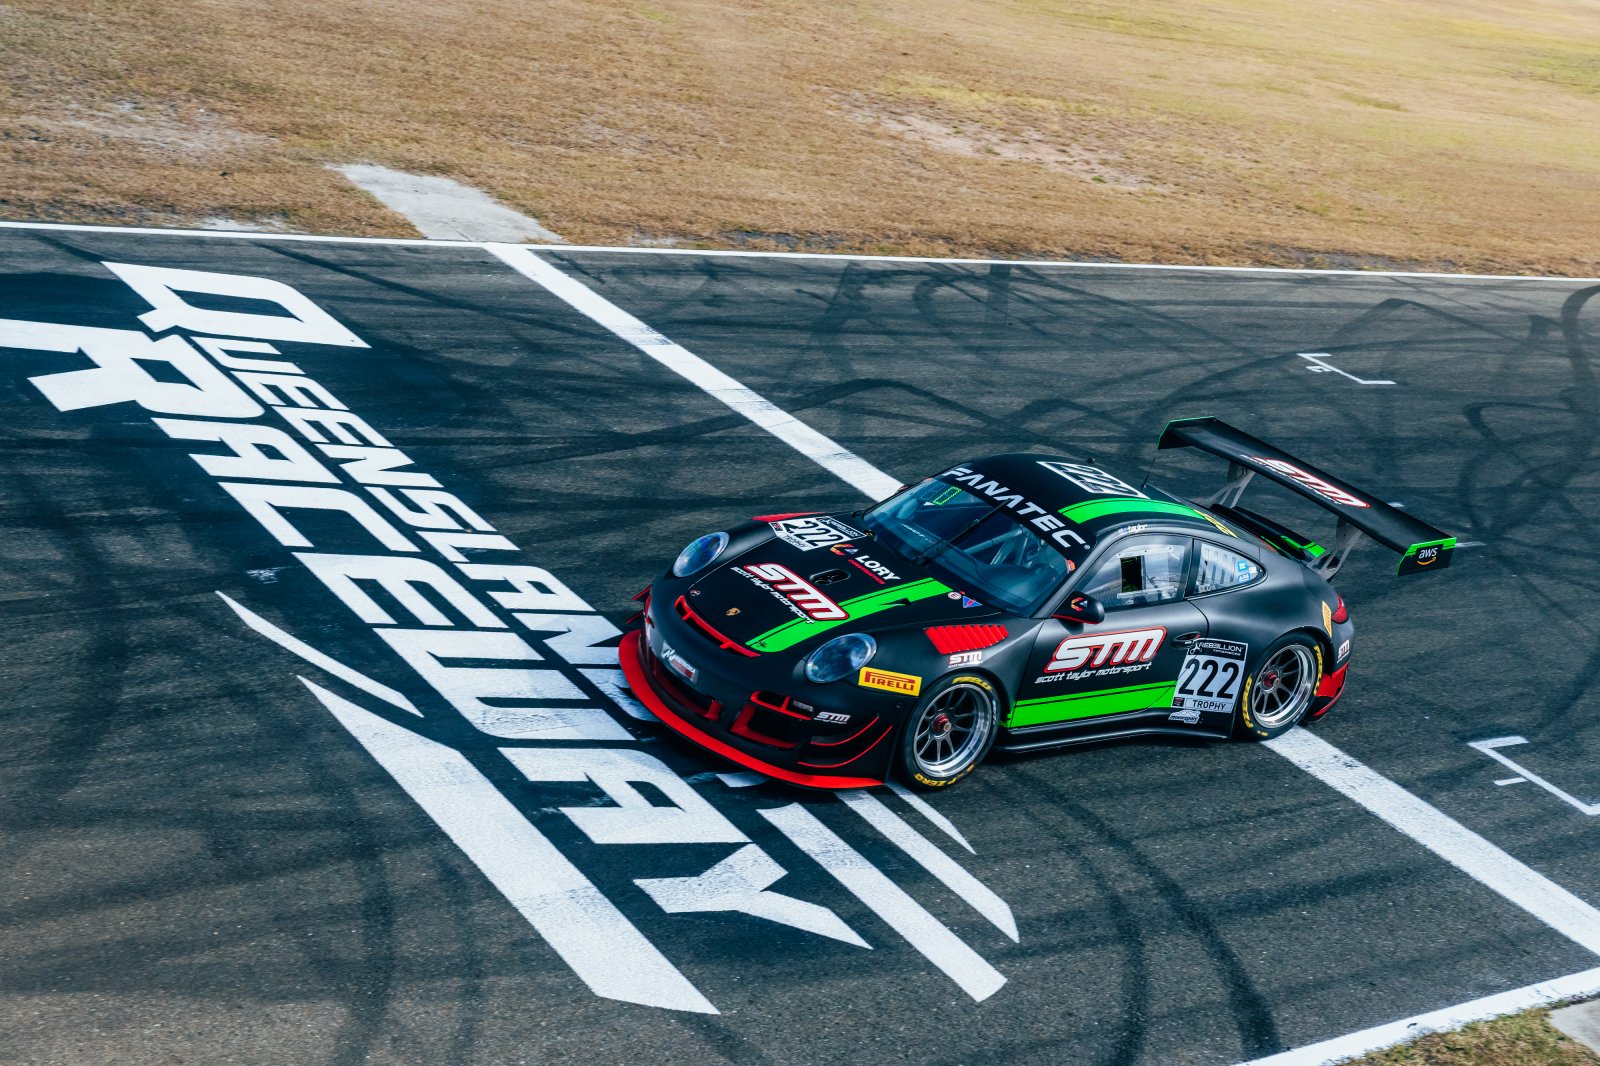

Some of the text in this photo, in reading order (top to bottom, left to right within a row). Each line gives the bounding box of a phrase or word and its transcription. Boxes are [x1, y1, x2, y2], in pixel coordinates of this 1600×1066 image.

[1250, 455, 1371, 508] STM
[942, 467, 1086, 548] FANATEC
[782, 520, 844, 548] 222
[1418, 547, 1438, 559] aws
[855, 555, 901, 580] LORY
[744, 563, 849, 621] STM
[0, 318, 873, 950] RACEWAY
[949, 651, 983, 665] STM
[1043, 625, 1167, 673] STM
[1198, 641, 1242, 653] REBELLION
[864, 671, 916, 692] PIRELLI
[1034, 662, 1152, 684] scott taylor motorsport
[1178, 658, 1240, 699] 222
[816, 711, 851, 722] STM
[1192, 700, 1227, 710] TROPHY
[914, 773, 947, 787] ZERO
